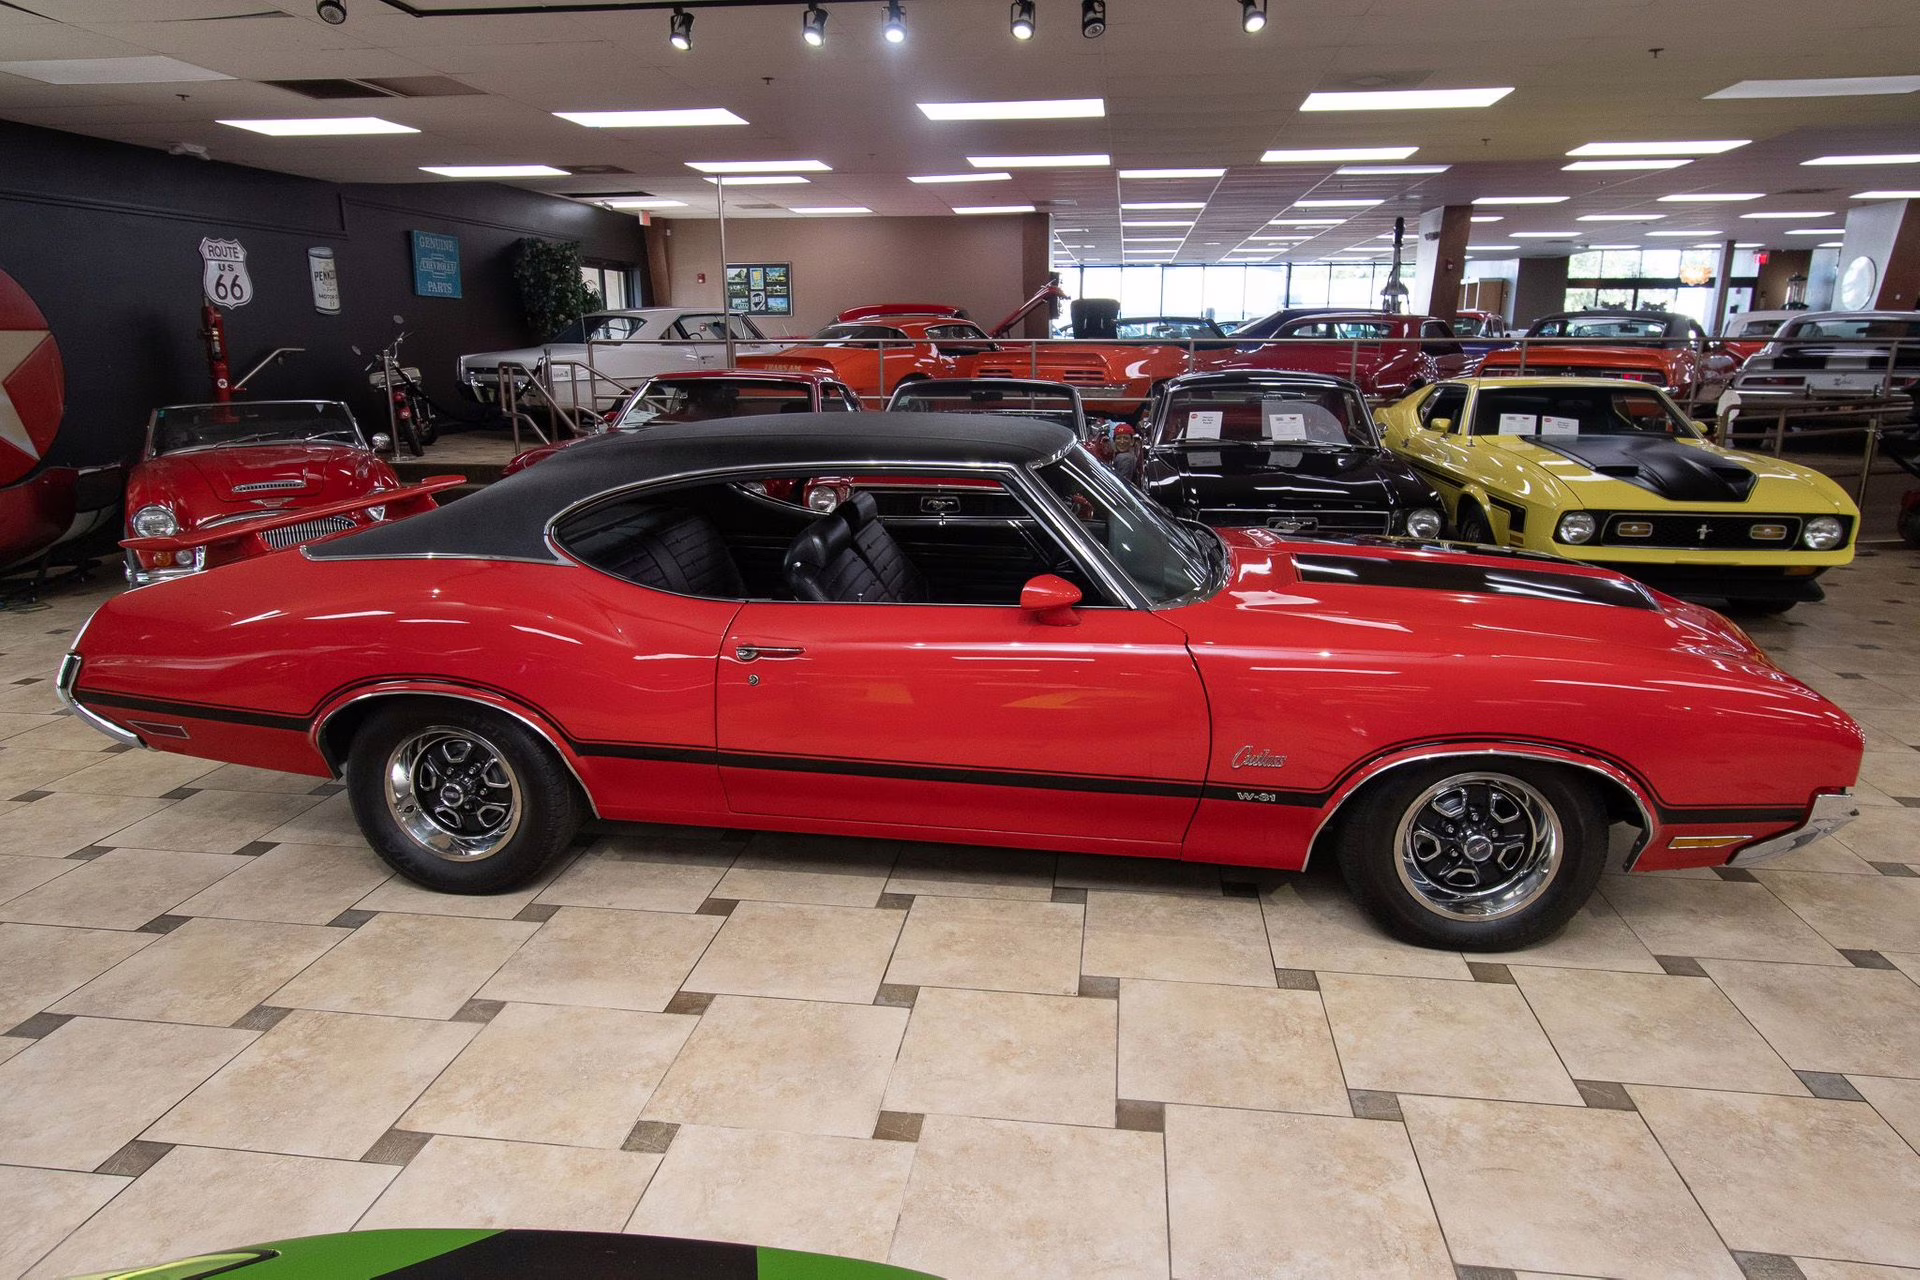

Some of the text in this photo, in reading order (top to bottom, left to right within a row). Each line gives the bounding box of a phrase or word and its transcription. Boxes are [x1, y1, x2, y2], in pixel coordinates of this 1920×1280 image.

[420, 236, 454, 252] GENUINE
[207, 245, 240, 259] ROUTE
[218, 263, 235, 272] US
[422, 260, 455, 272] CHEVROLET
[215, 274, 243, 301] 66
[427, 280, 453, 294] PARTS
[1232, 745, 1287, 768] Cutlass
[1237, 792, 1276, 802] W-31
